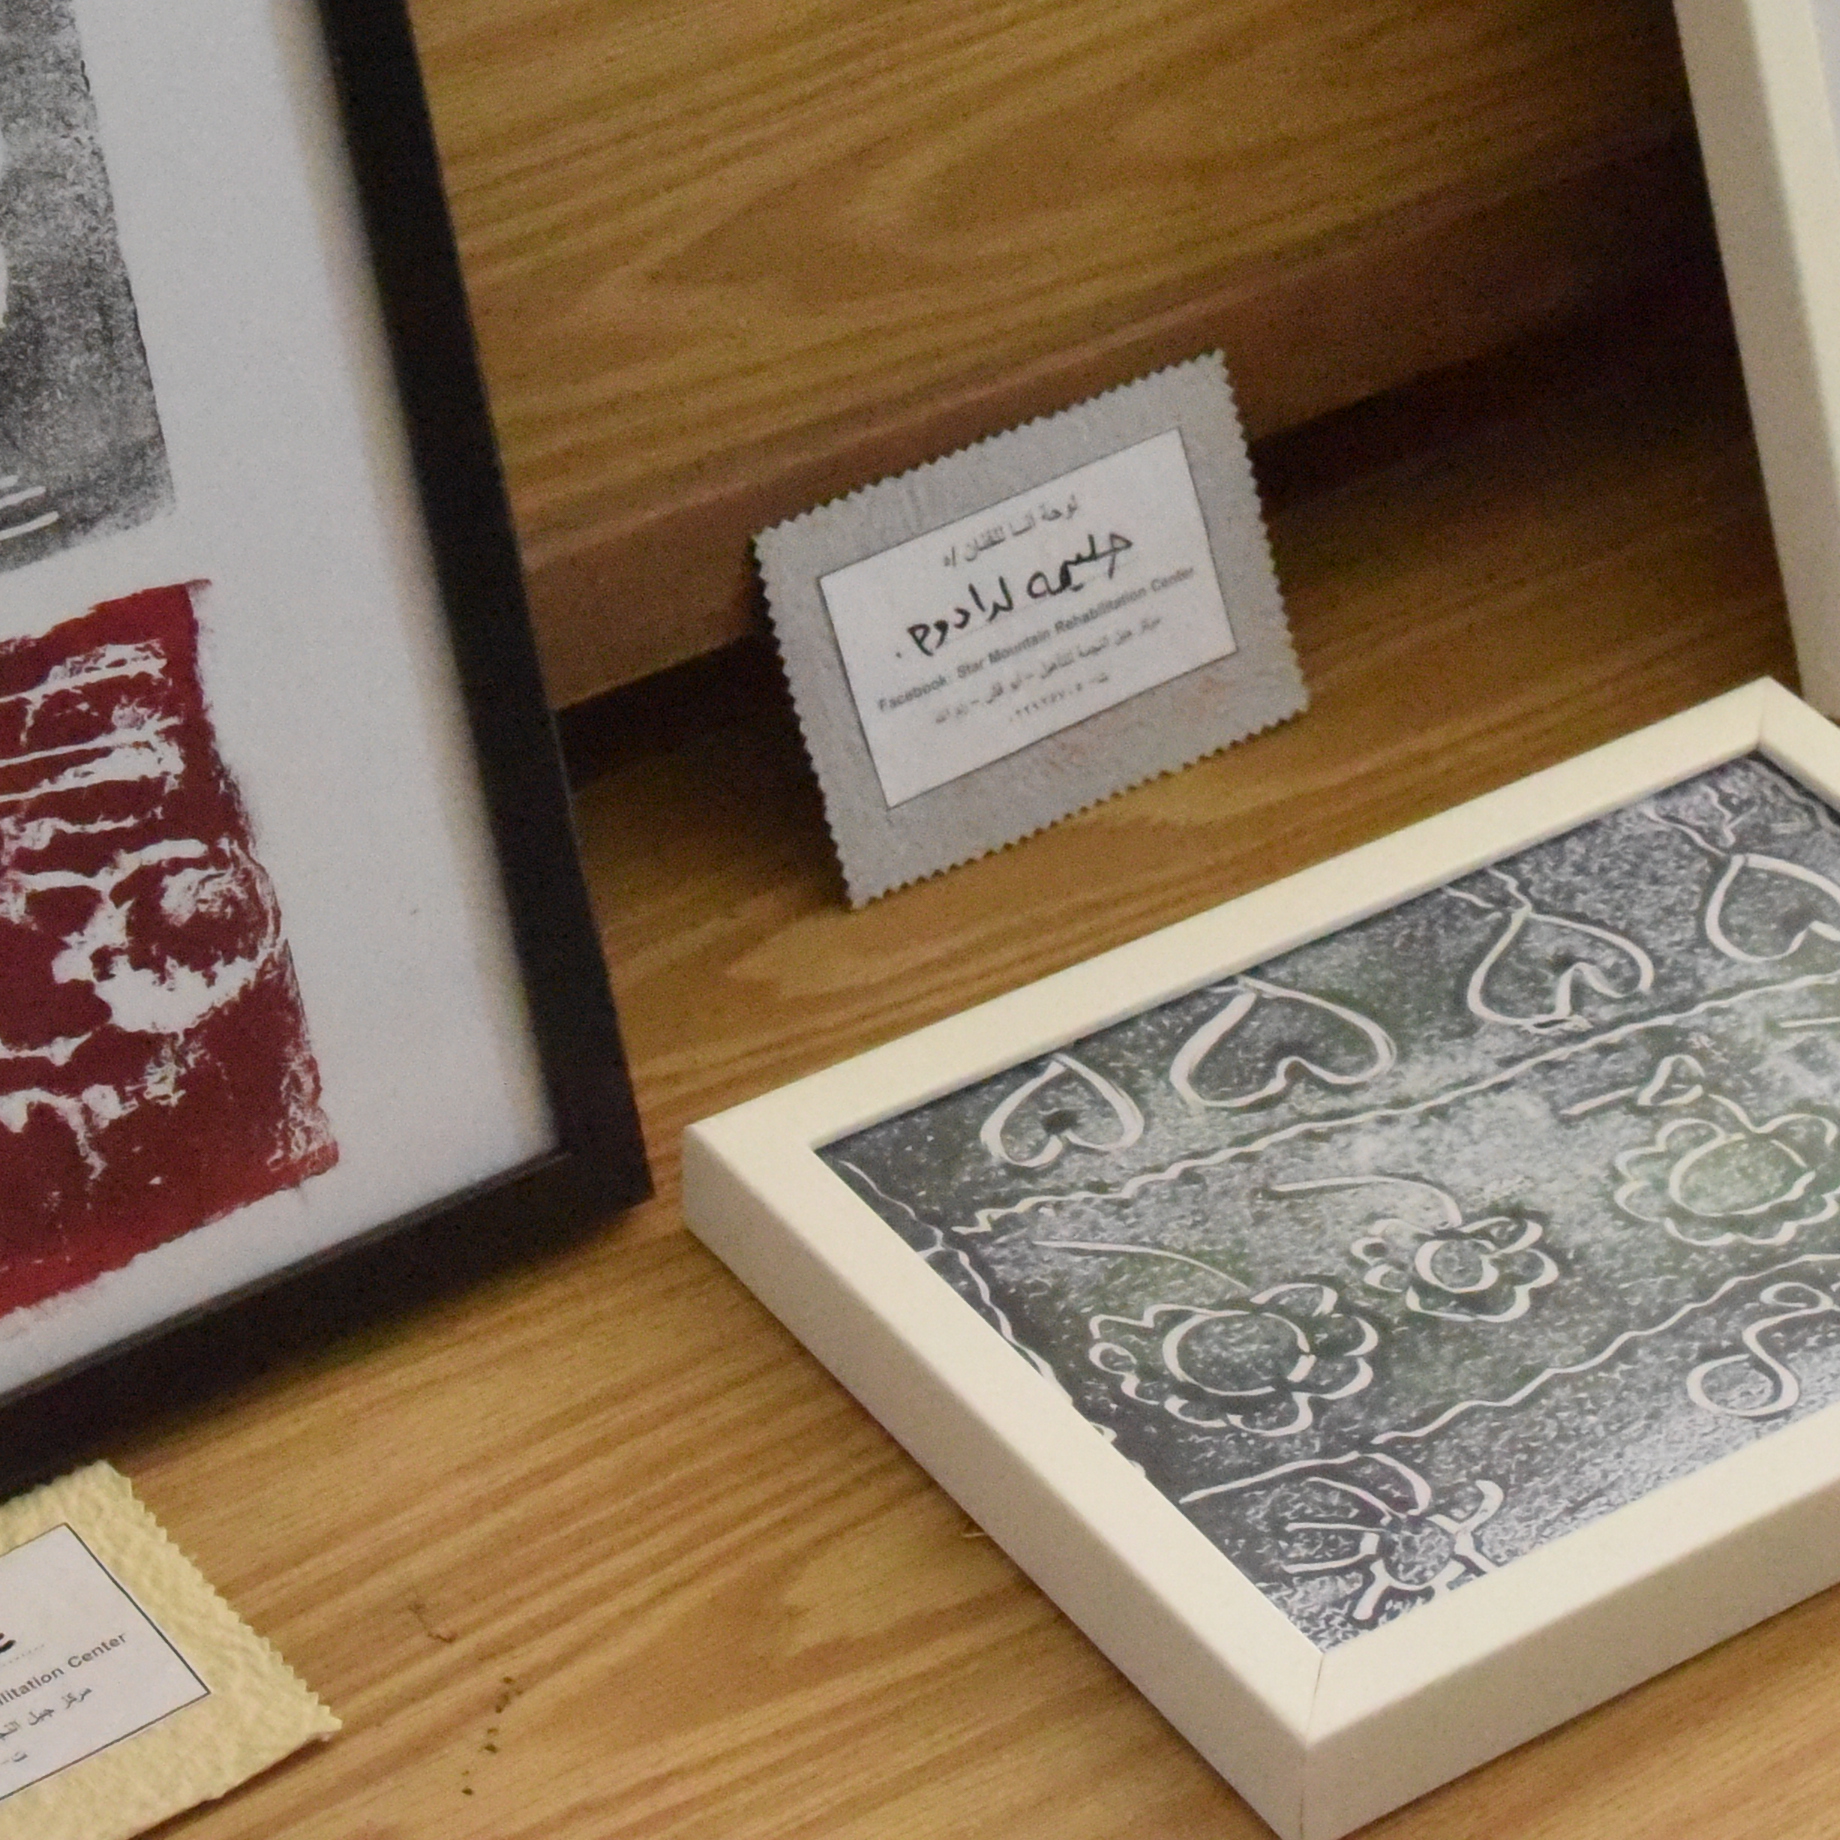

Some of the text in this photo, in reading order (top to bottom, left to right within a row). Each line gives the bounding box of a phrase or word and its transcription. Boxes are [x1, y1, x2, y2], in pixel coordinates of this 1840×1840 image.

[957, 659, 985, 679] Star
[988, 629, 1051, 664] Mountain
[68, 1633, 128, 1669] Center
[61, 1686, 93, 1710] مركز
[28, 1708, 55, 1727] جبل
